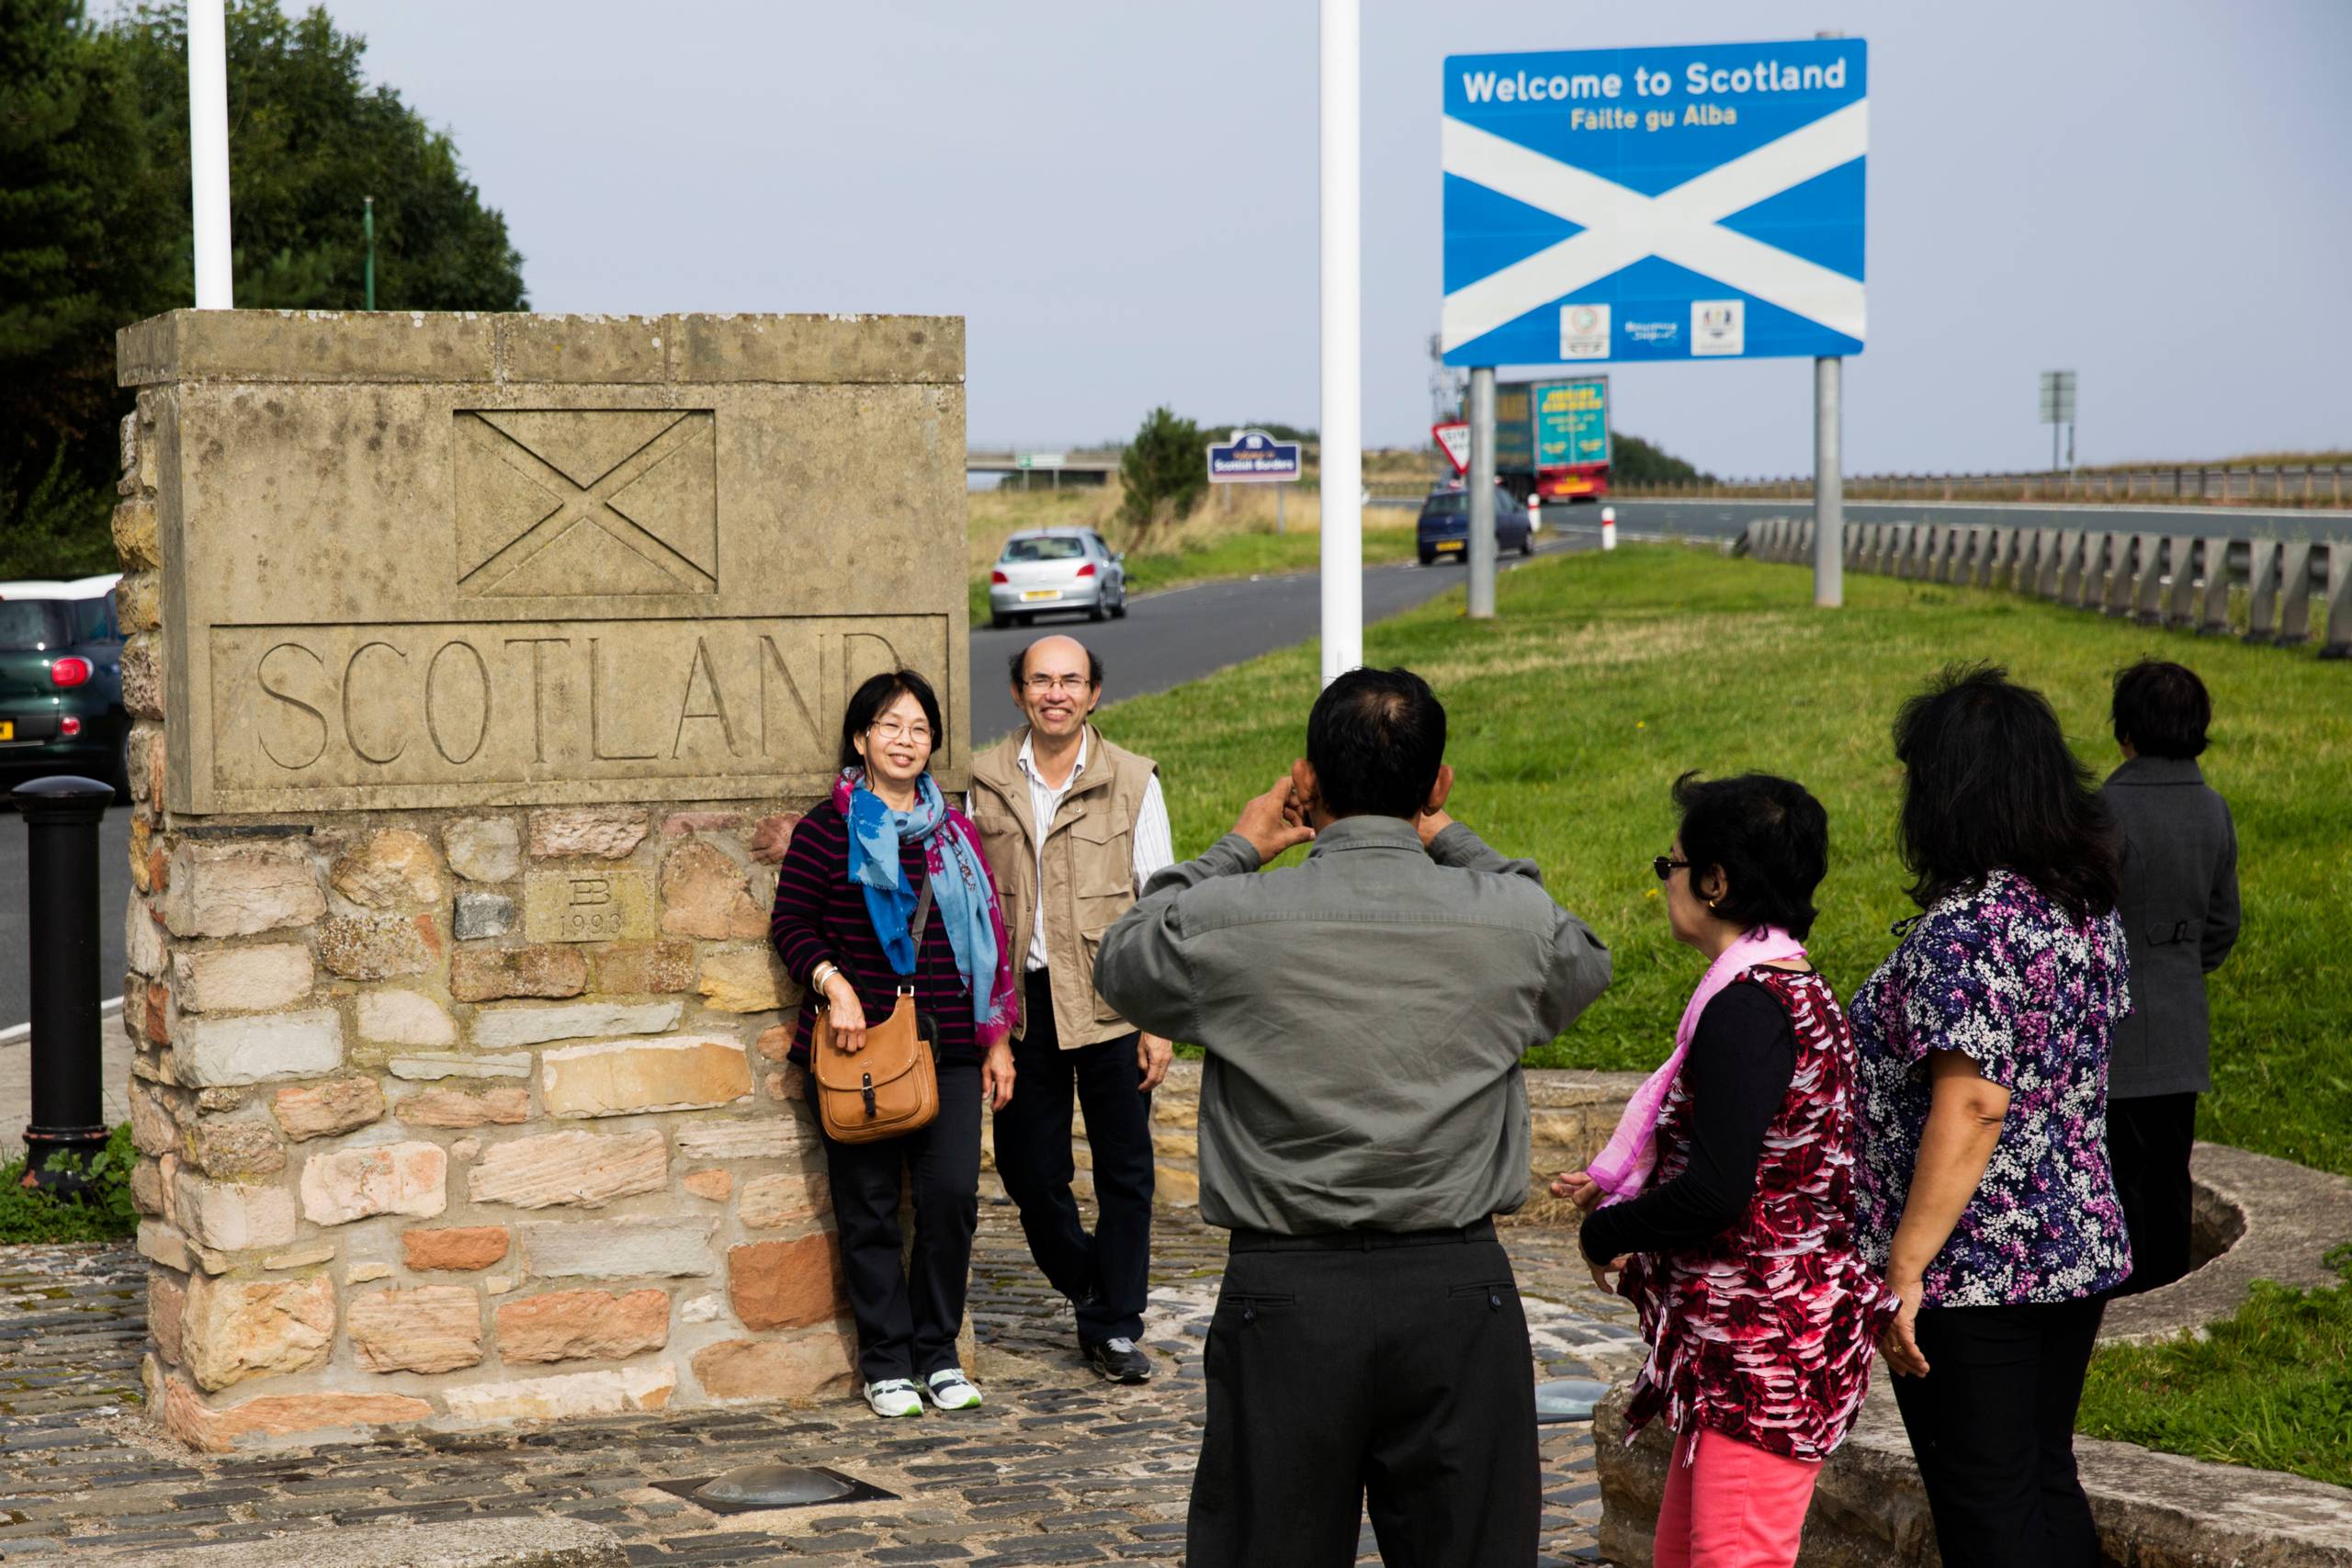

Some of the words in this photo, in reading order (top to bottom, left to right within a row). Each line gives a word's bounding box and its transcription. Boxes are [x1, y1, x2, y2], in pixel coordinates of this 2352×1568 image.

[1463, 69, 1623, 103] Welcome
[1634, 64, 1672, 96] to
[1685, 57, 1847, 95] Scotland
[1645, 108, 1675, 132] gu
[1682, 103, 1738, 127] Alba
